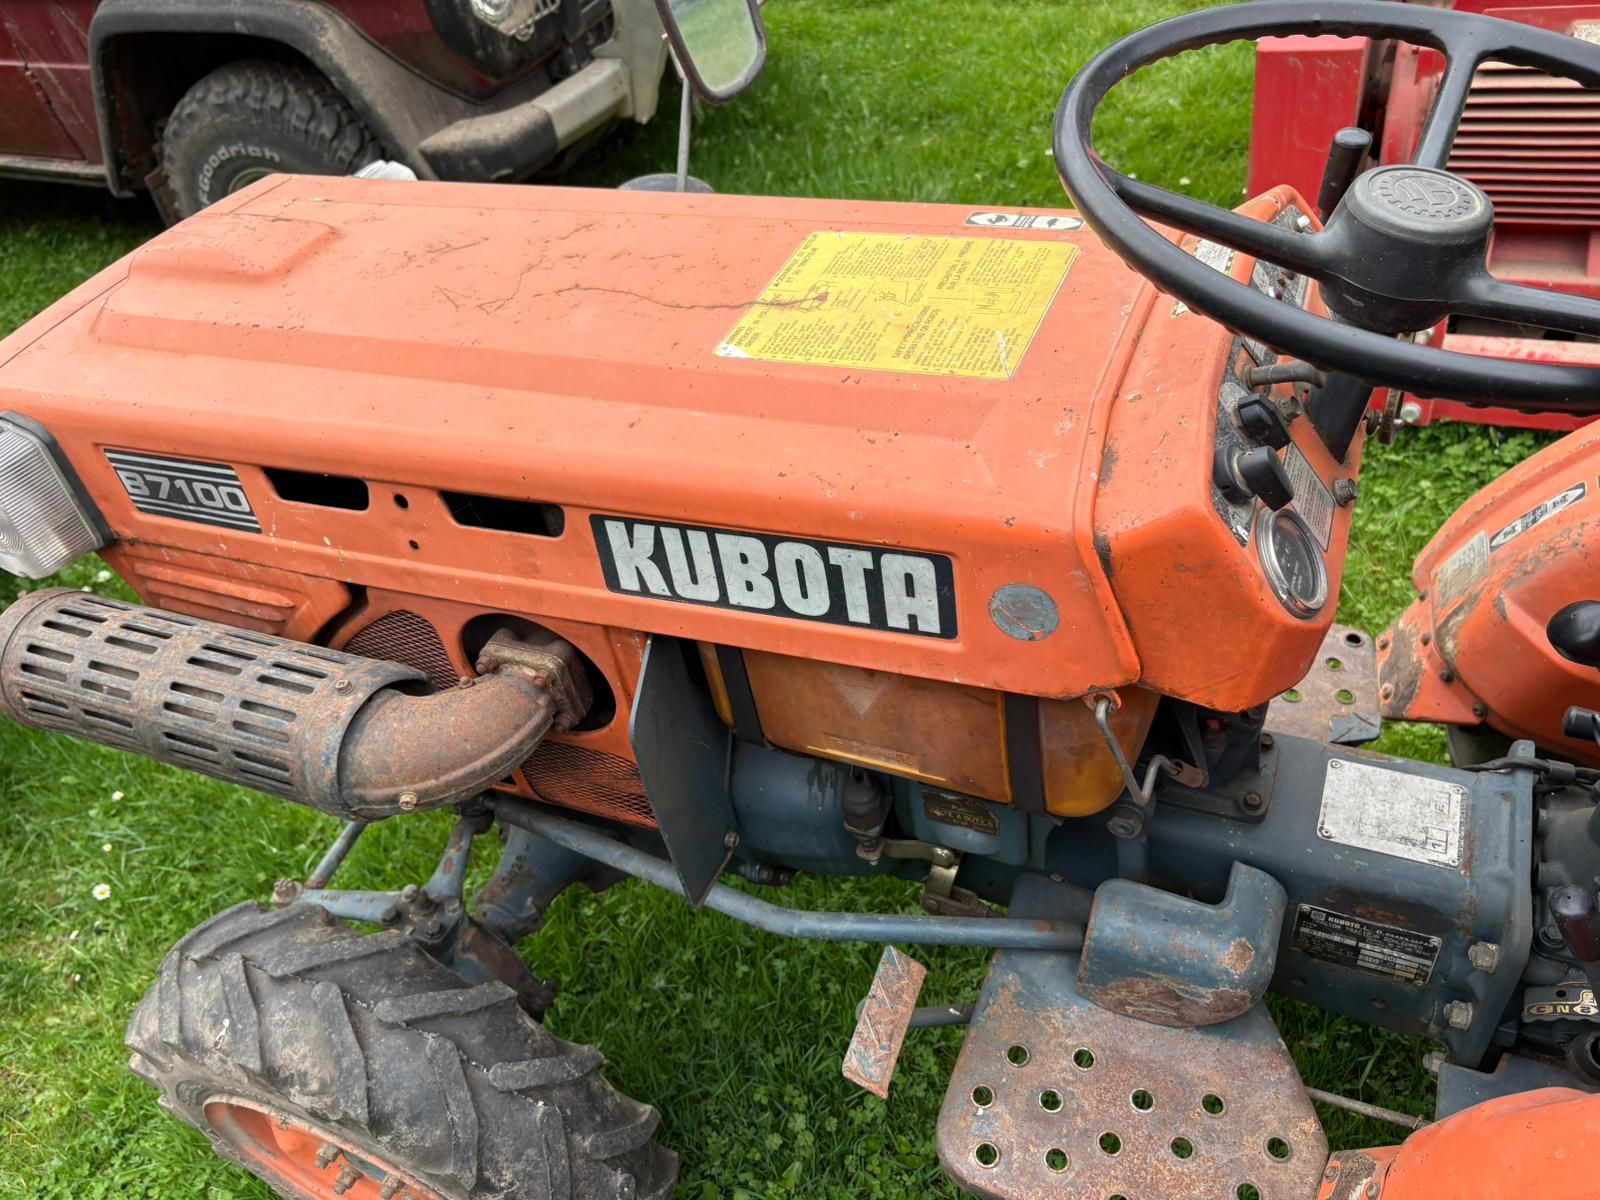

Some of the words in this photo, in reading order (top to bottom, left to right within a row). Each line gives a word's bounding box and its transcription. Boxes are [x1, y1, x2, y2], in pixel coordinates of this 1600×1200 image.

[198, 142, 280, 208] FGoodrich
[901, 332, 926, 359] OPERATING
[116, 470, 250, 512] B7100
[604, 520, 941, 634] KUBOTA
[1556, 1004, 1570, 1014] N
